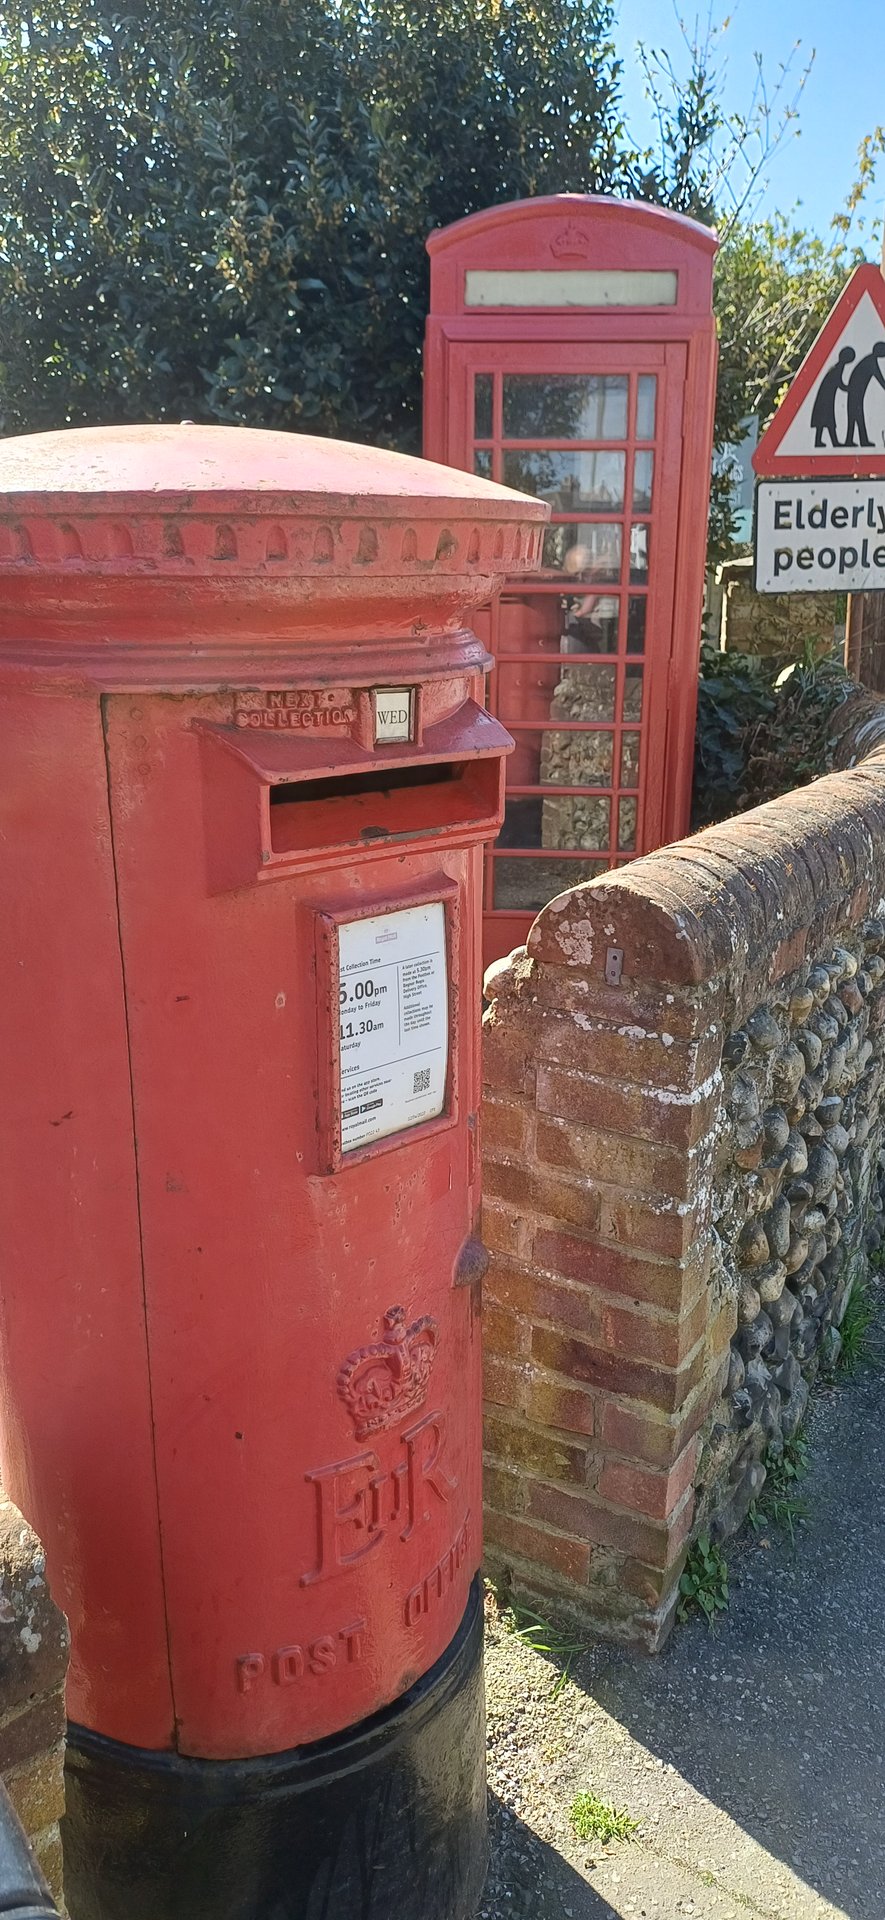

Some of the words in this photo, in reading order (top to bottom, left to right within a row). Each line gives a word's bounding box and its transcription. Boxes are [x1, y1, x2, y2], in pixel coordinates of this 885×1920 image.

[773, 498, 885, 534] Elderly
[773, 538, 885, 577] people
[266, 690, 325, 708] NEXT
[234, 706, 355, 728] COLLECTION
[377, 709, 408, 726] WED
[346, 961, 369, 972] Collection
[369, 957, 381, 965] Time
[340, 1006, 357, 1016] onday
[364, 1000, 381, 1009] Friday
[340, 1041, 361, 1052] aturday
[341, 1064, 360, 1075] ervices
[236, 1617, 367, 1693] POST
